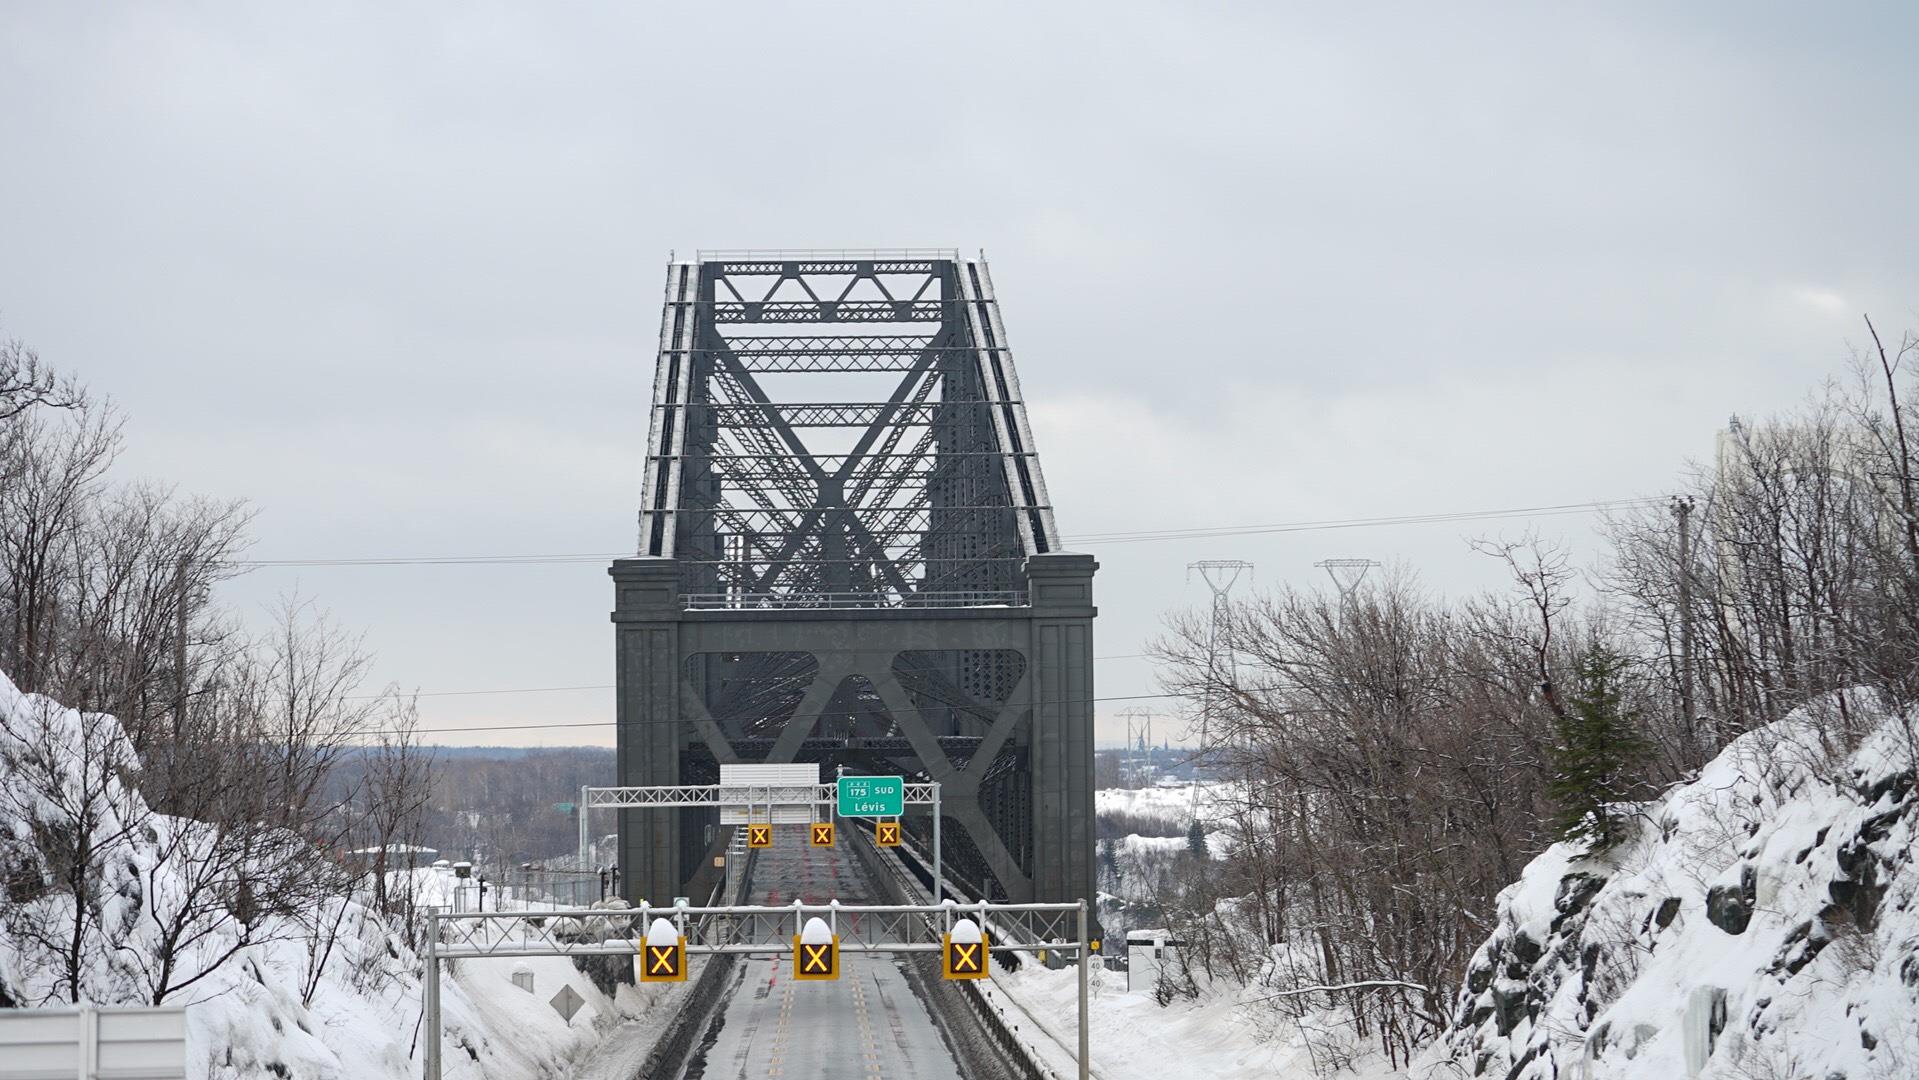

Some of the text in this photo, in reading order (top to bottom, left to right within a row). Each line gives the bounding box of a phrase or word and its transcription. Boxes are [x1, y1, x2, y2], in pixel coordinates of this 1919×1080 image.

[850, 786, 894, 797] 175 SUD
[854, 801, 886, 812] Lévis
